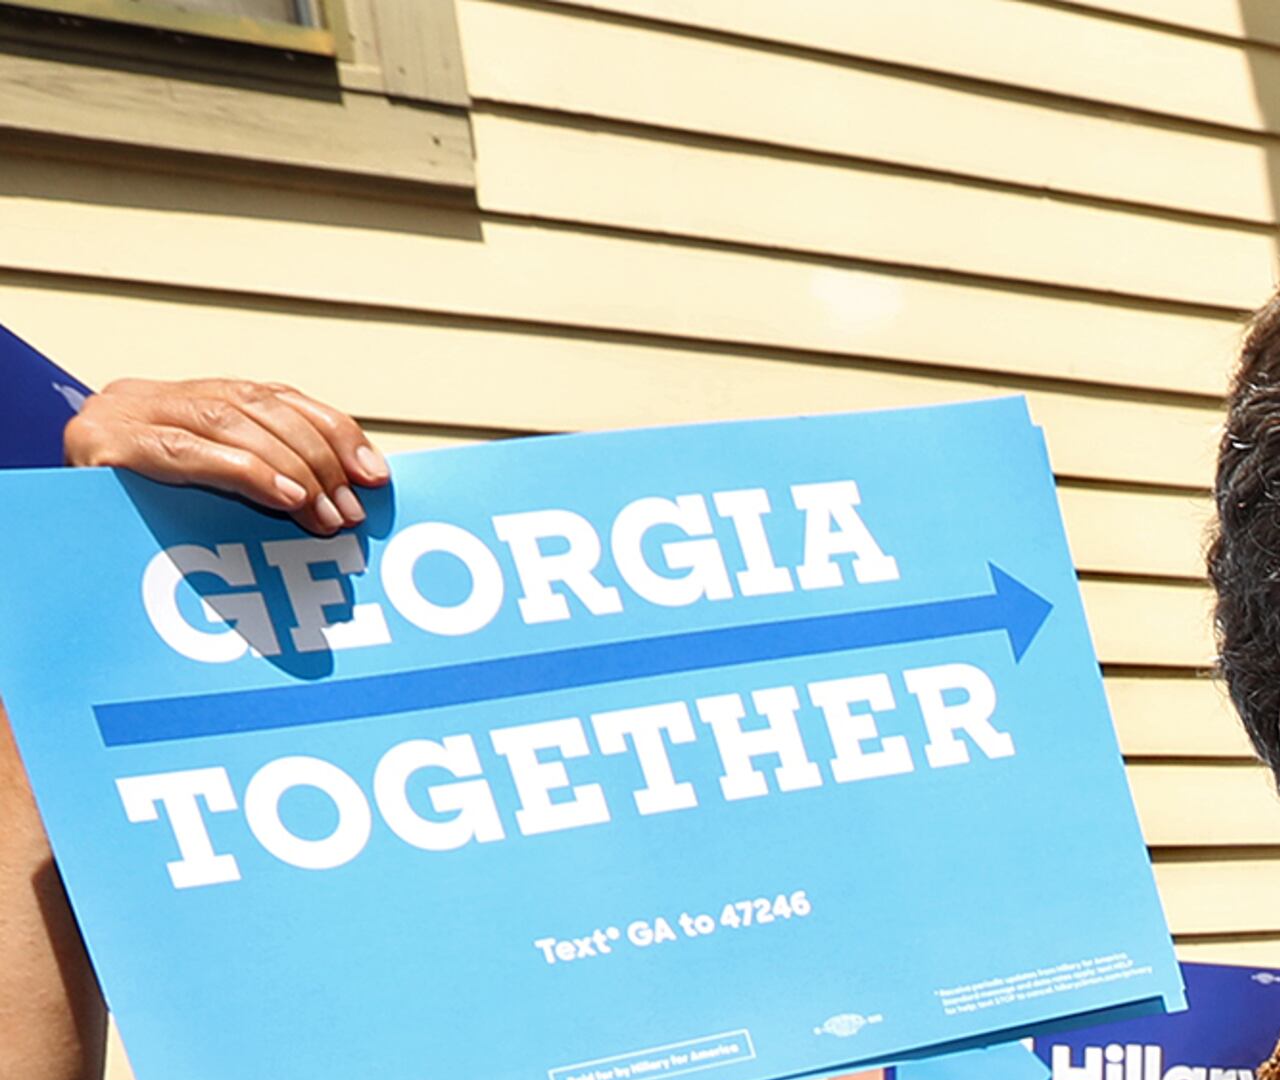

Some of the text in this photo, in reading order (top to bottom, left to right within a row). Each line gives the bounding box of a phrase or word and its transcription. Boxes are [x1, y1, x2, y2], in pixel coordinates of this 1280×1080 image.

[141, 480, 900, 664] GEORGIA
[115, 663, 1015, 889] TOGETHER
[626, 916, 677, 947] GA
[678, 911, 716, 938] to
[720, 890, 811, 929] 47246
